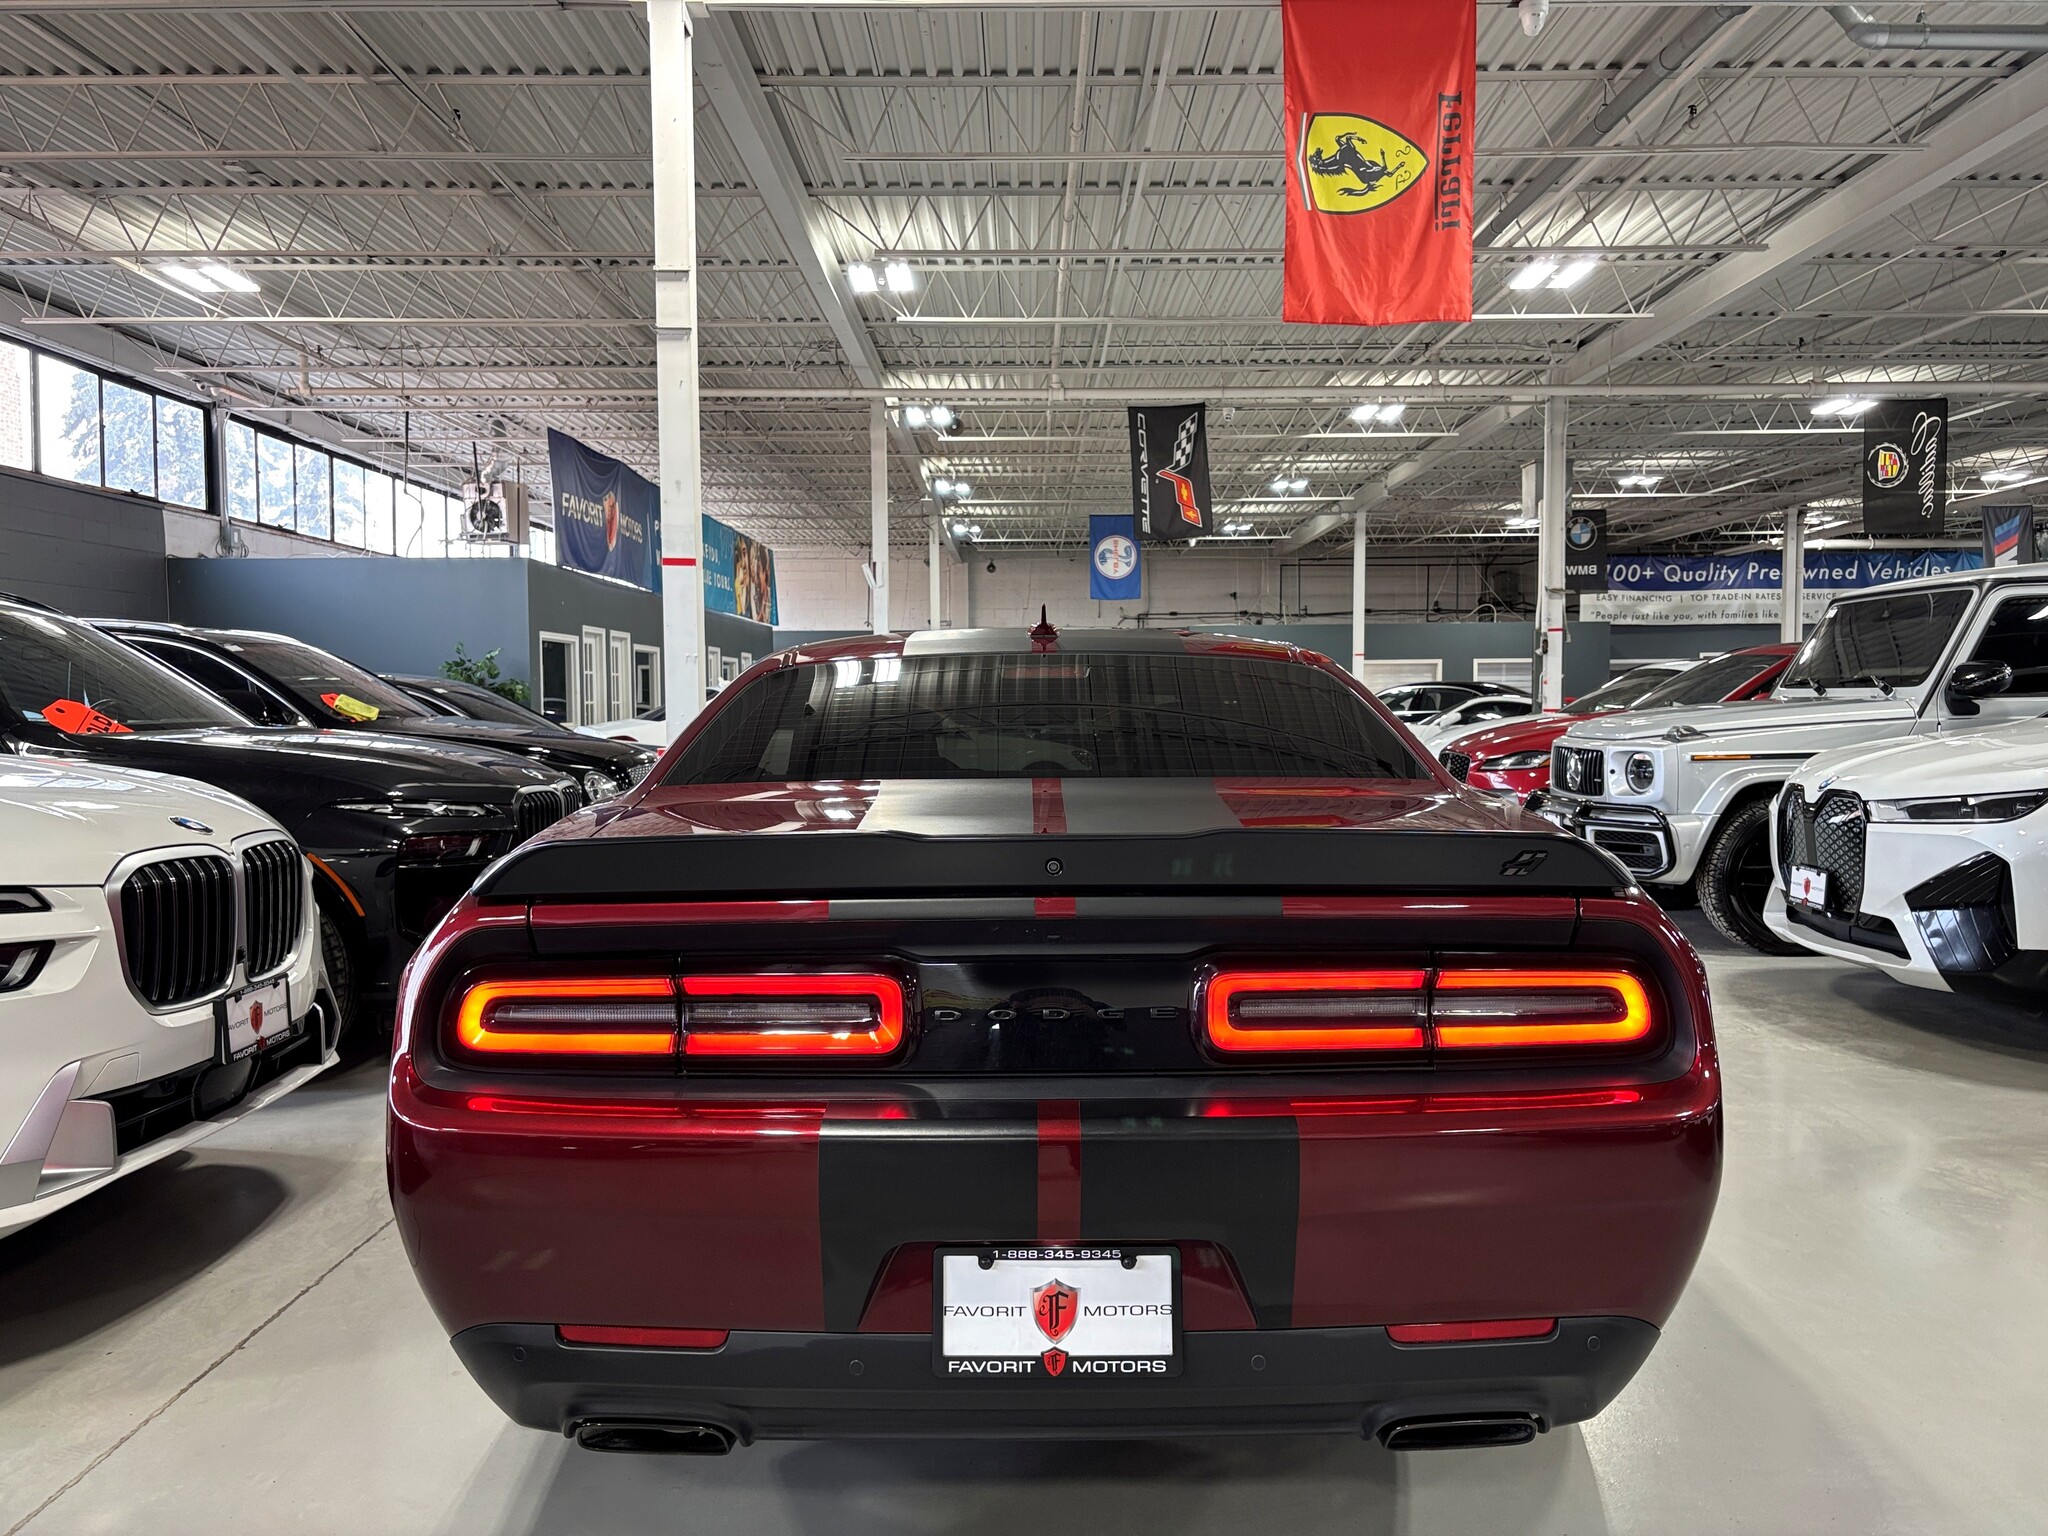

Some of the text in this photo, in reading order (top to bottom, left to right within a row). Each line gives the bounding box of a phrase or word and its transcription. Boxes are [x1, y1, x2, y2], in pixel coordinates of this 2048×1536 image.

[1137, 412, 1151, 534] CORVETTE
[562, 492, 603, 528] FAVORIT
[1663, 562, 1739, 585] Quality
[1868, 558, 1951, 580] Vehicles
[1596, 593, 1618, 602] EASY
[1621, 594, 1673, 603] FINANCING
[1690, 593, 1708, 602] TOP
[1711, 592, 1752, 601] TRADE-IN
[1755, 592, 1782, 601] RATES
[1631, 611, 1650, 621] just
[1652, 610, 1670, 620] like
[1673, 611, 1693, 621] you,
[1697, 610, 1717, 619] with
[1721, 609, 1759, 619] families
[1762, 609, 1779, 618] like
[228, 1002, 288, 1031] AVORIT MOTORS
[934, 1007, 1178, 1021] DODGE
[233, 1029, 290, 1061] FAVORIT MOTORS
[992, 1250, 1122, 1259] 1-888-345-9345
[943, 1304, 1173, 1317] FAVORIT MOTORS
[948, 1360, 1167, 1373] FAVORIT MOTORS
